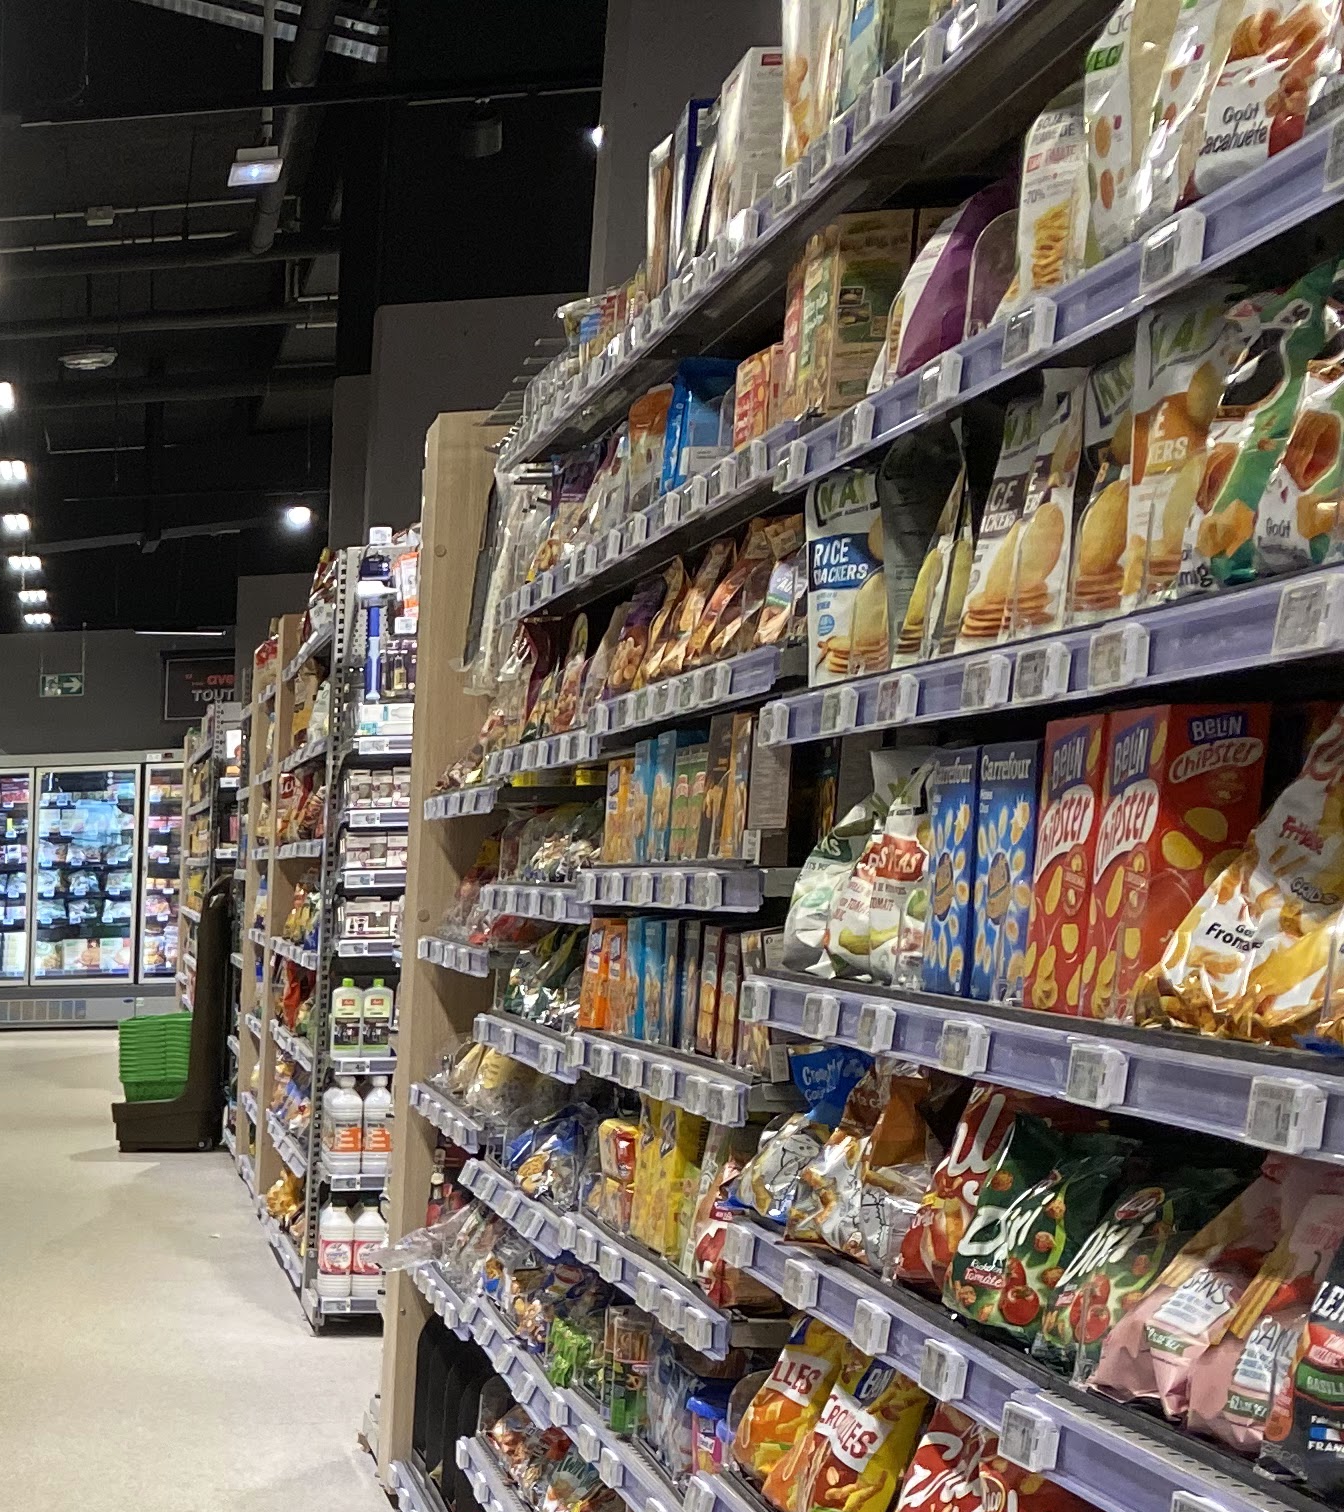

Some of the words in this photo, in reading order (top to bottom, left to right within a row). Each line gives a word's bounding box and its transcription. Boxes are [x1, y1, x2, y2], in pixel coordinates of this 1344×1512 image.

[1223, 105, 1259, 127] Goût
[814, 537, 850, 566] RICE
[192, 689, 233, 702] TOUT
[981, 751, 1032, 782] Carrefour
[1169, 741, 1253, 779] Chipster
[1183, 1267, 1234, 1305] SANS
